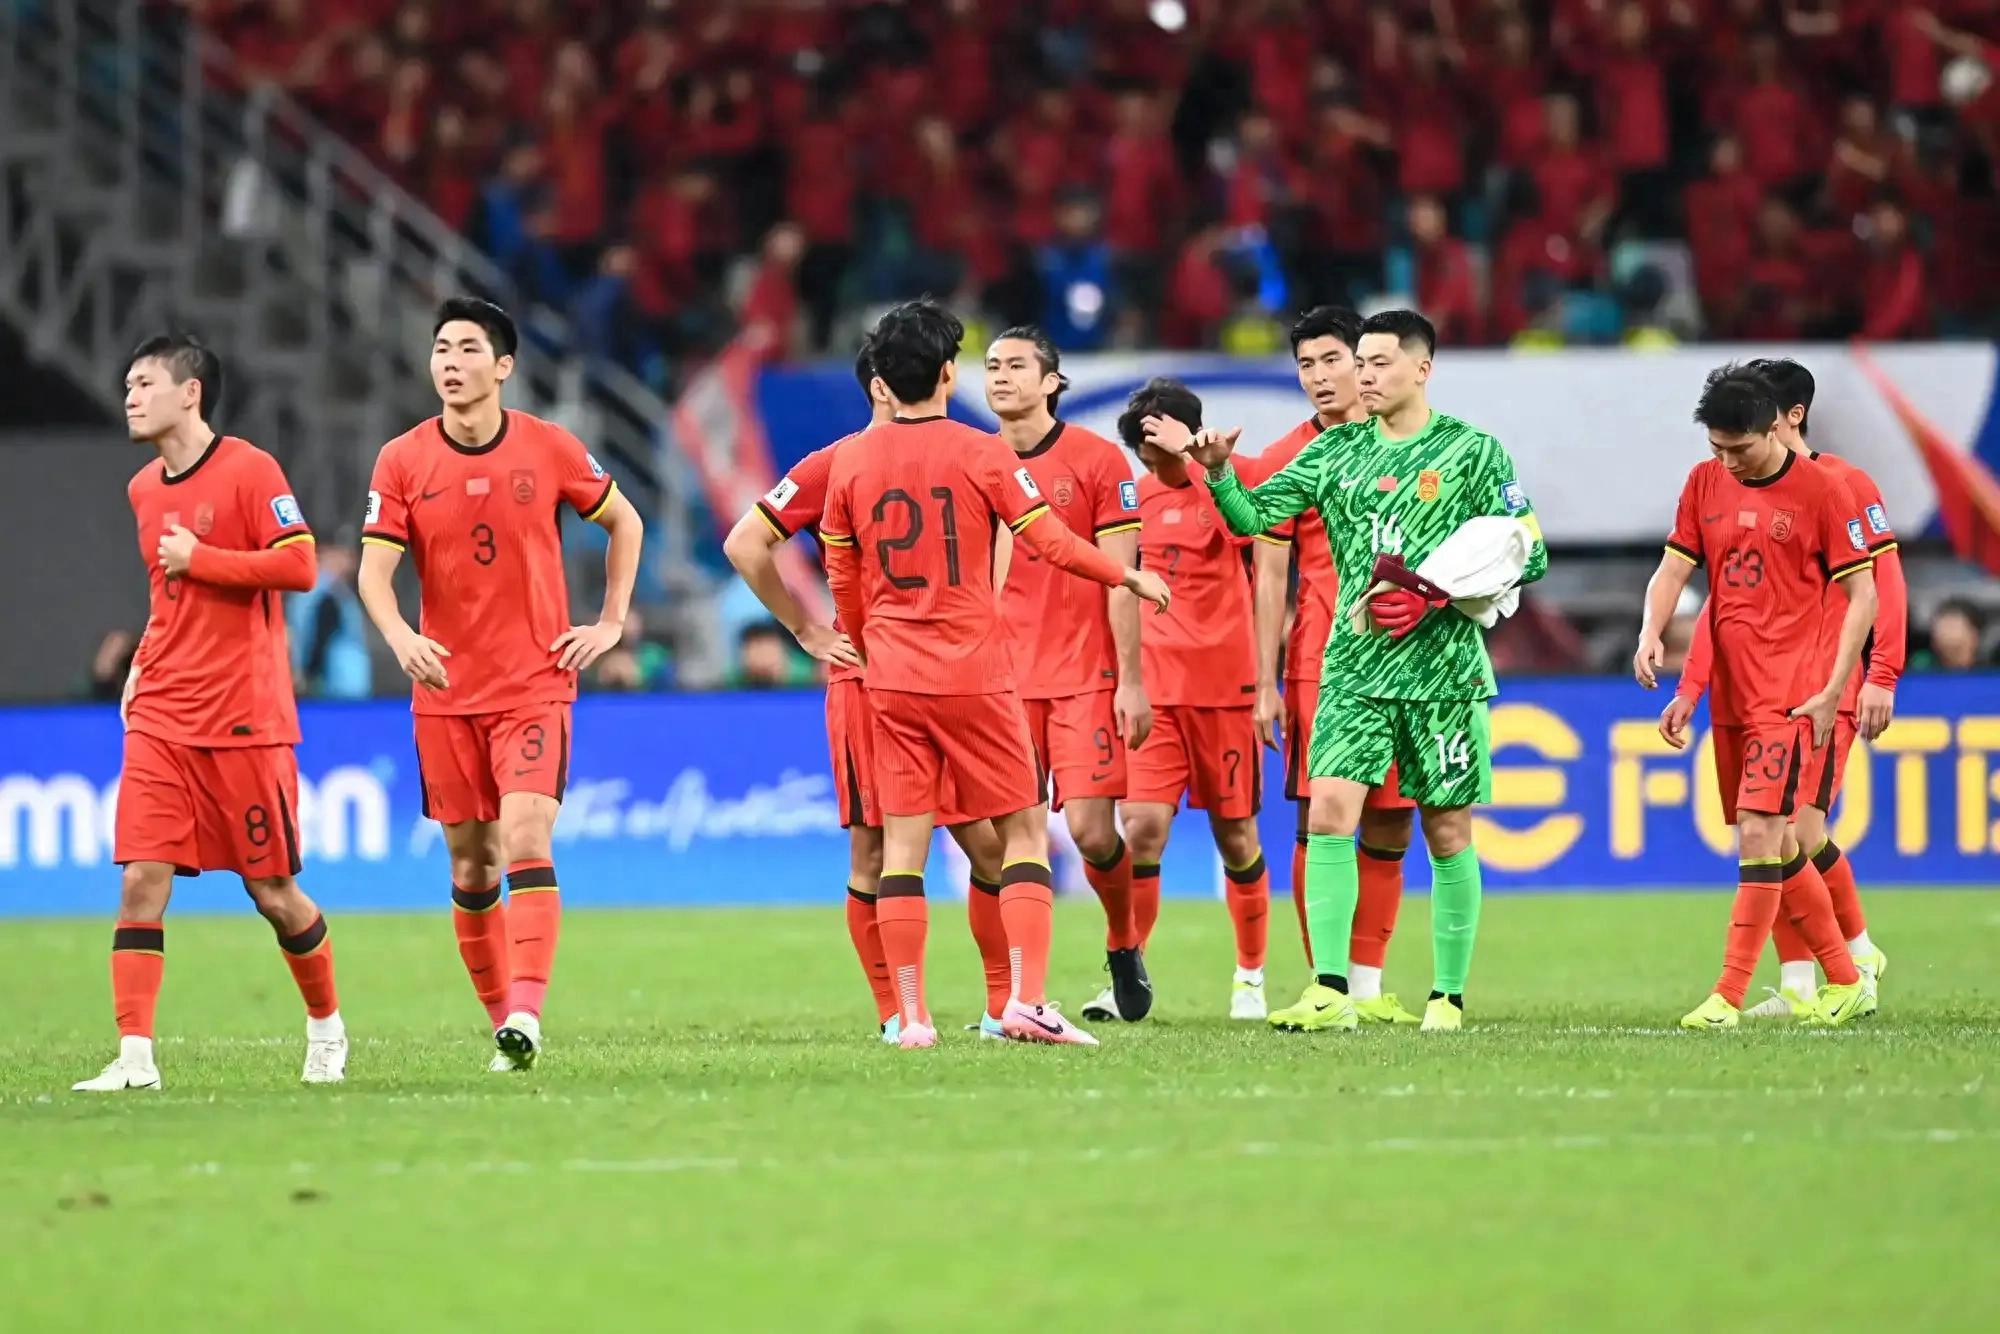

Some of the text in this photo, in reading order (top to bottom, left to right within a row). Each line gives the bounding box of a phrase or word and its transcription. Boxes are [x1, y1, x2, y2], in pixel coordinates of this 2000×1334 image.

[470, 523, 497, 566] 3
[872, 487, 961, 590] 21
[1366, 512, 1403, 556] 14
[1724, 547, 1765, 588] 23
[519, 724, 546, 761] 3
[1093, 727, 1113, 766] 9
[1434, 730, 1470, 774] 14
[1744, 740, 1787, 780] 23
[1222, 749, 1241, 787] 7
[245, 804, 271, 847] 8
